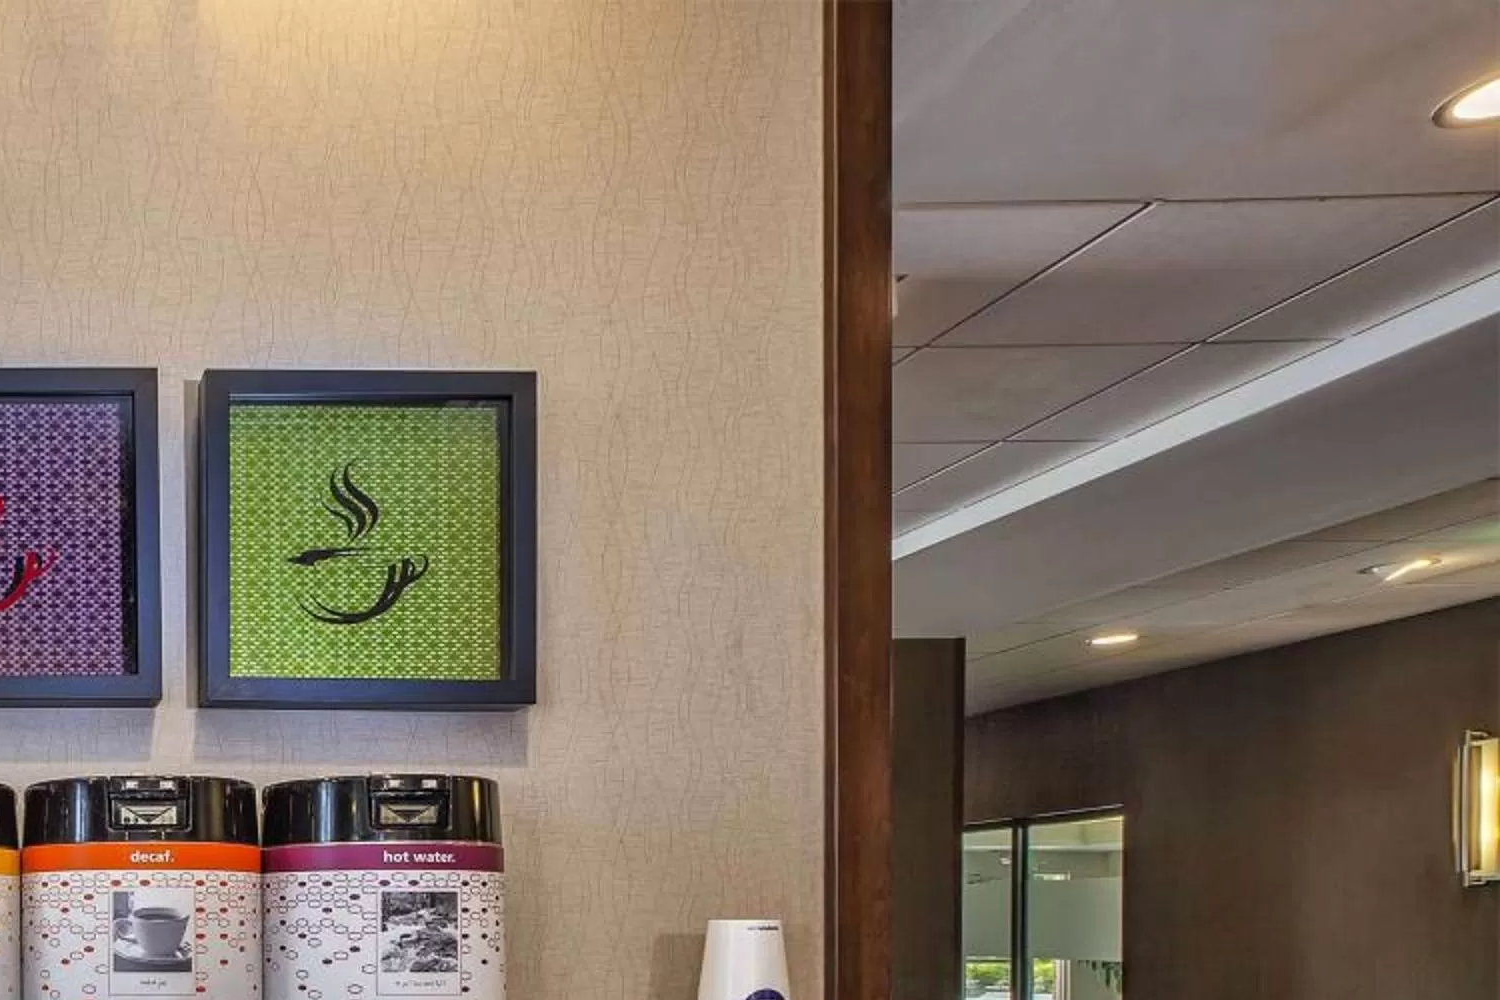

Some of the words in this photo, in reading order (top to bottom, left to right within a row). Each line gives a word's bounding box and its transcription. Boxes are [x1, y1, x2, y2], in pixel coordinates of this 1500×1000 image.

[130, 849, 175, 864] decaf.
[383, 850, 409, 863] hot
[412, 851, 456, 863] water.
